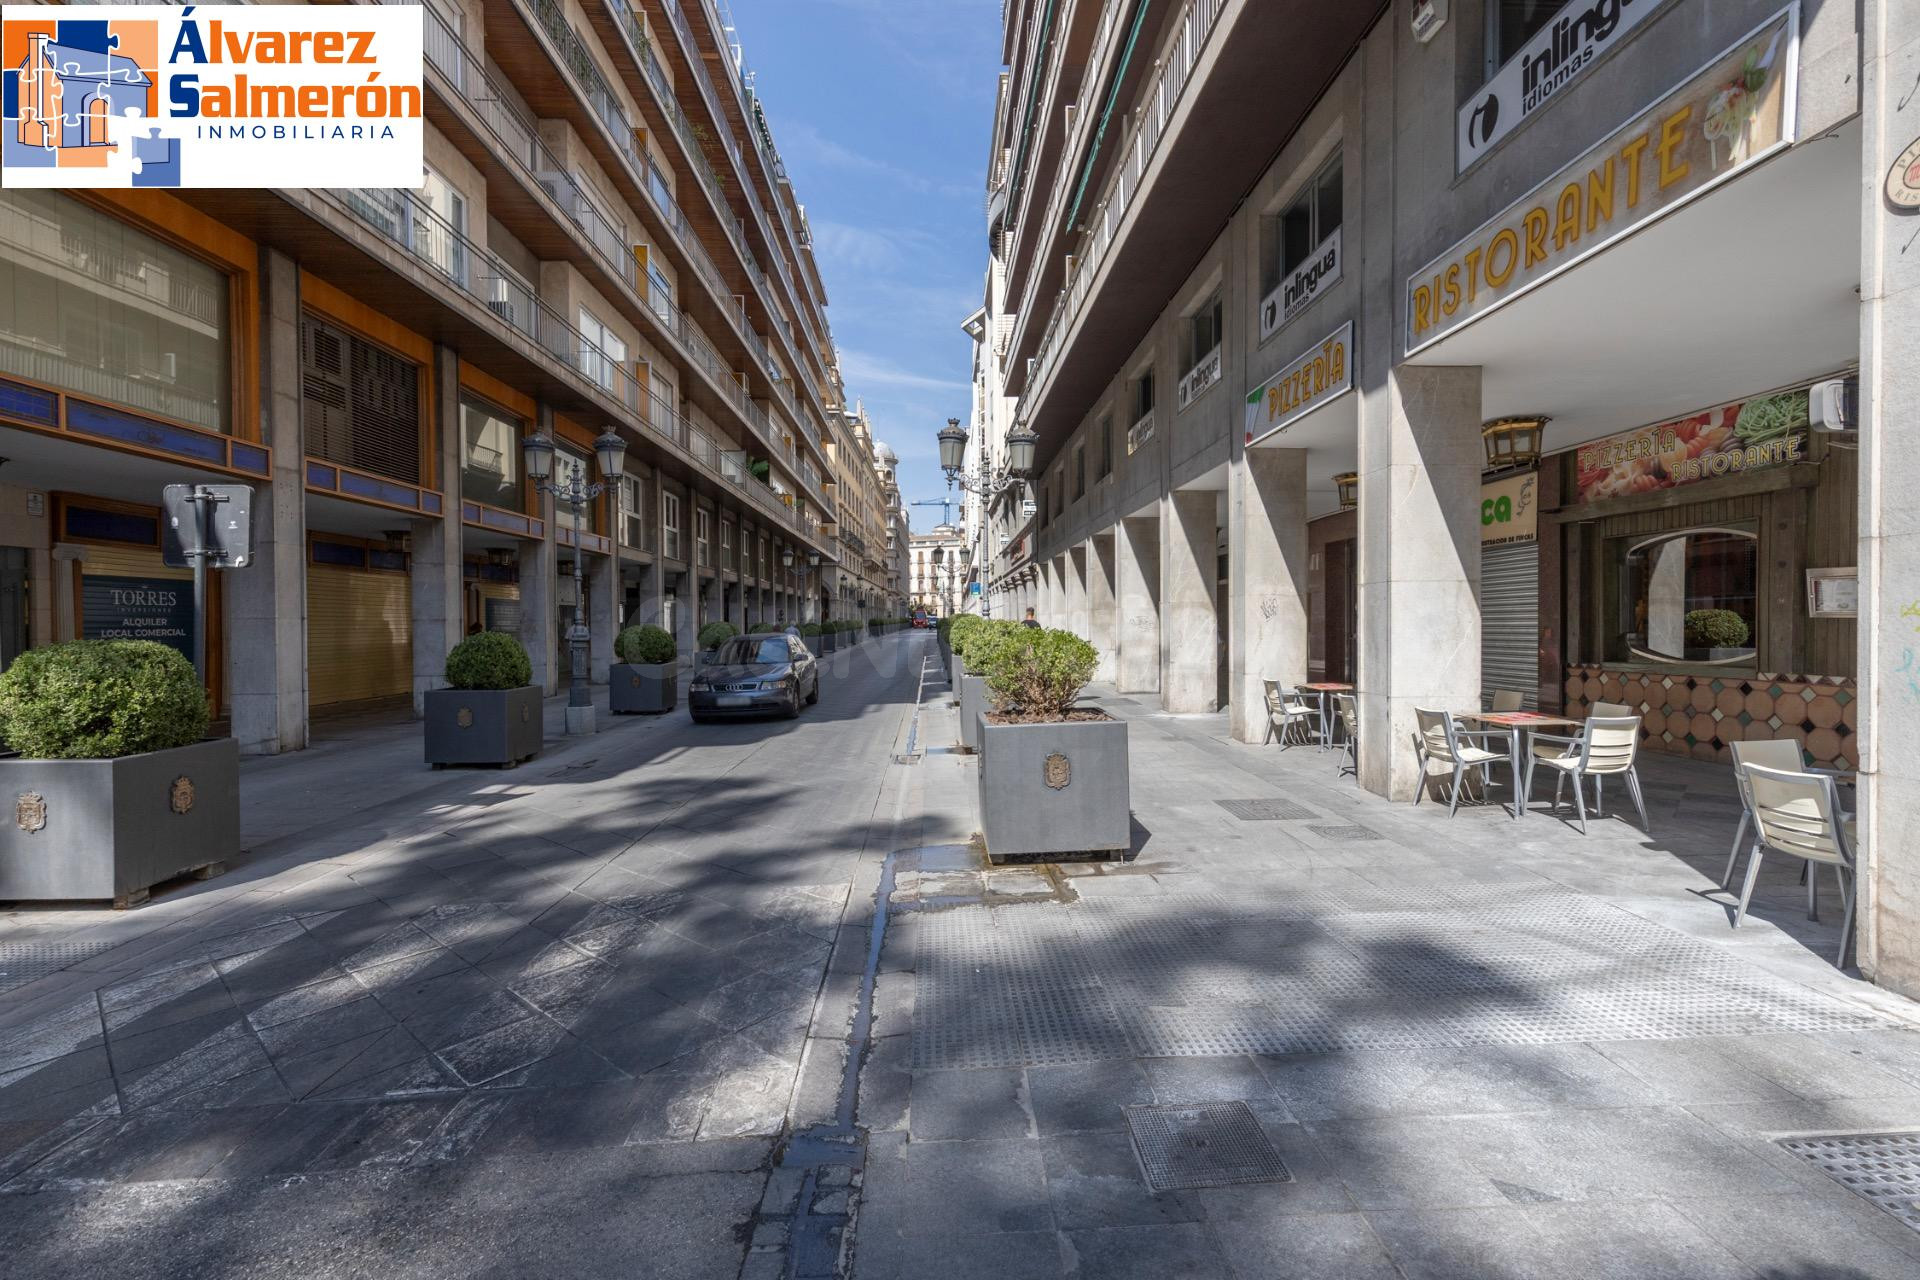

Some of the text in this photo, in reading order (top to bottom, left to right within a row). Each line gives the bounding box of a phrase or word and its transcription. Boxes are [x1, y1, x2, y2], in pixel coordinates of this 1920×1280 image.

[1522, 0, 1633, 98] inling
[1522, 45, 1593, 116] idiomas
[1412, 104, 1695, 335] RISTORANTE
[1284, 247, 1336, 309] inlingua
[1671, 436, 1801, 482] RISTORANTE
[110, 589, 177, 607] TORRES
[122, 618, 168, 627] ALQUILER
[101, 628, 187, 638] LOCAL COMERCIAL
